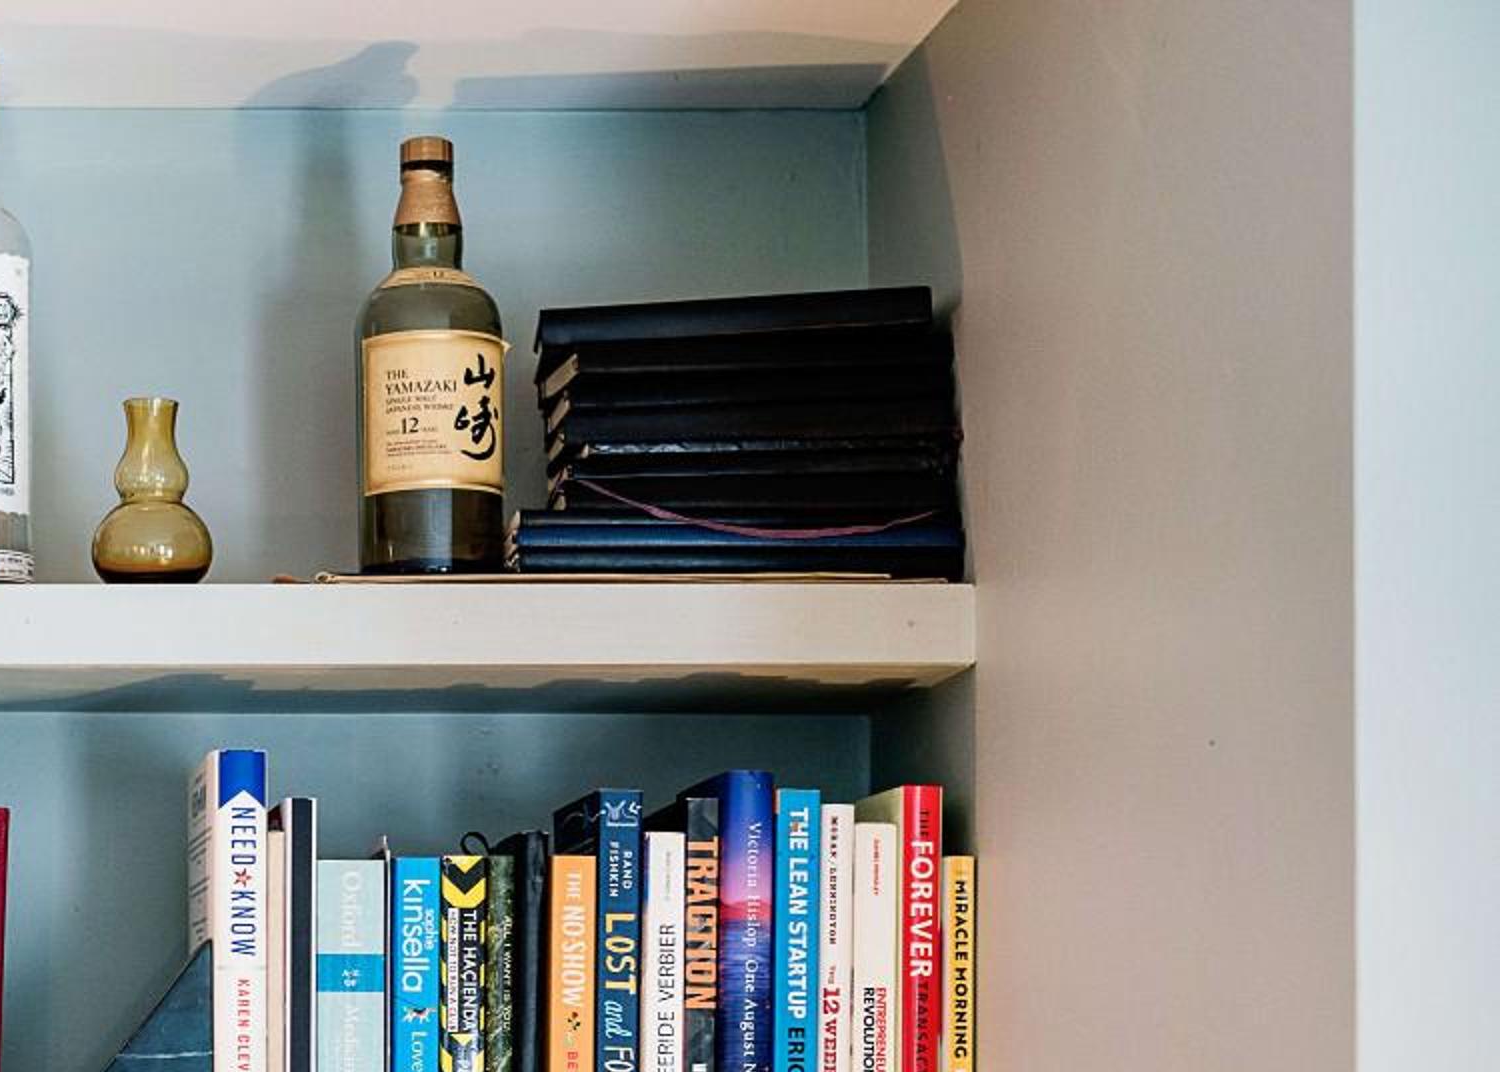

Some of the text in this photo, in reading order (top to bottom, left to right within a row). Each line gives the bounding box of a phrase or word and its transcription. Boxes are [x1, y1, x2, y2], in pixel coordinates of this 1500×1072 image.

[386, 369, 409, 381] THE
[386, 380, 457, 396] YAMAZAKI
[401, 417, 419, 435] 12
[454, 353, 499, 461] 山崎
[747, 821, 762, 887] Victoria
[789, 807, 809, 850] THE
[231, 807, 257, 957] NEED KNOW
[565, 872, 581, 899] THE
[608, 841, 621, 898] FISHKIN
[621, 850, 633, 889] RAND
[788, 857, 809, 914] LEAN
[340, 871, 363, 948] Oxford
[402, 879, 431, 993] kinsella
[421, 908, 438, 949] sophie
[685, 835, 719, 1010] TRACTION
[742, 894, 762, 948] Hislop
[909, 839, 934, 977] FOREVER
[954, 879, 968, 960] MIRACLE
[461, 909, 477, 1031] THE HAÇIENDA
[503, 915, 512, 986] ALL WANT
[604, 913, 637, 995] LOST
[658, 923, 676, 1001] VERBIER
[744, 959, 759, 993] One
[787, 920, 808, 1018] STARTUP
[237, 978, 251, 1028] KAREN
[604, 1000, 629, 1038] and
[739, 998, 759, 1056] August
[823, 987, 841, 1015] 12
[954, 966, 968, 1058] MORNING
[411, 1031, 428, 1072] Love
